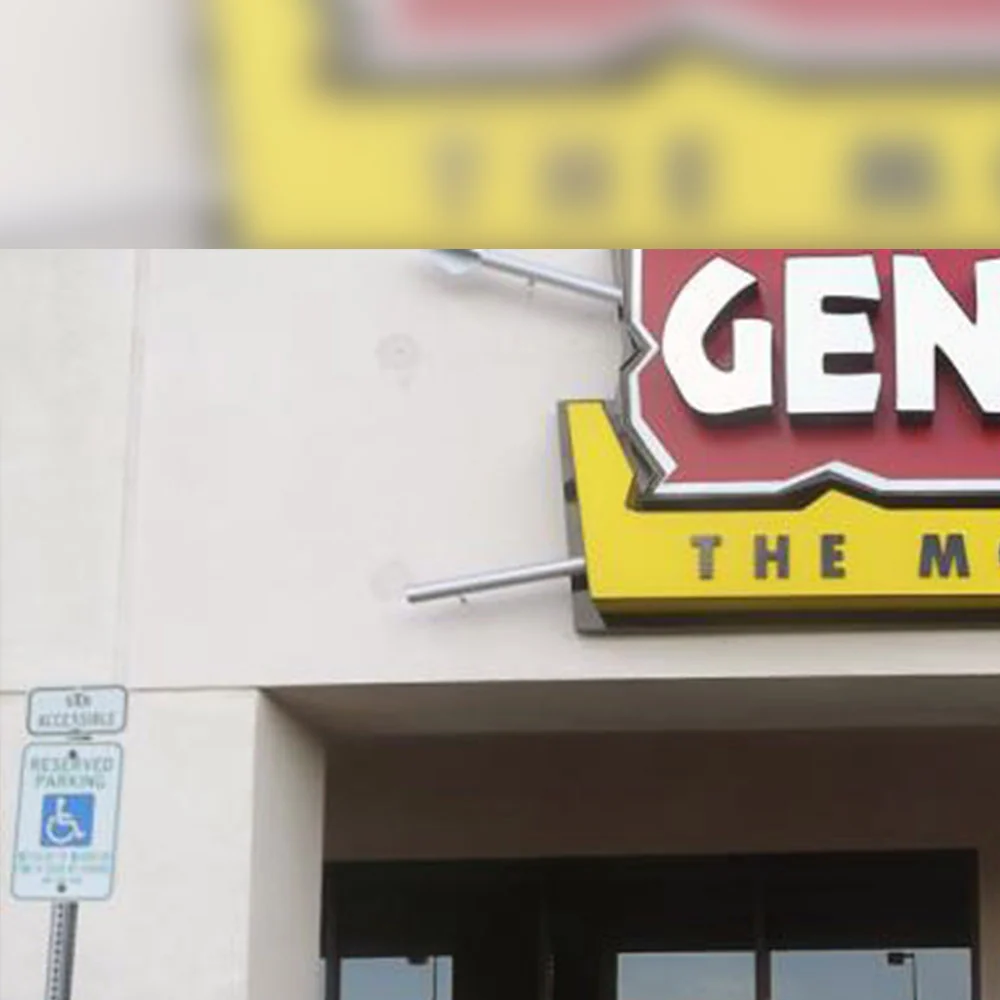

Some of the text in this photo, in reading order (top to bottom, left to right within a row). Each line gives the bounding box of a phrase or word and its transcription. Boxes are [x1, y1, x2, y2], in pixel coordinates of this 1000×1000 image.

[690, 535, 846, 580] THE
[30, 756, 114, 773] RESERVED
[34, 773, 107, 790] PARKING
